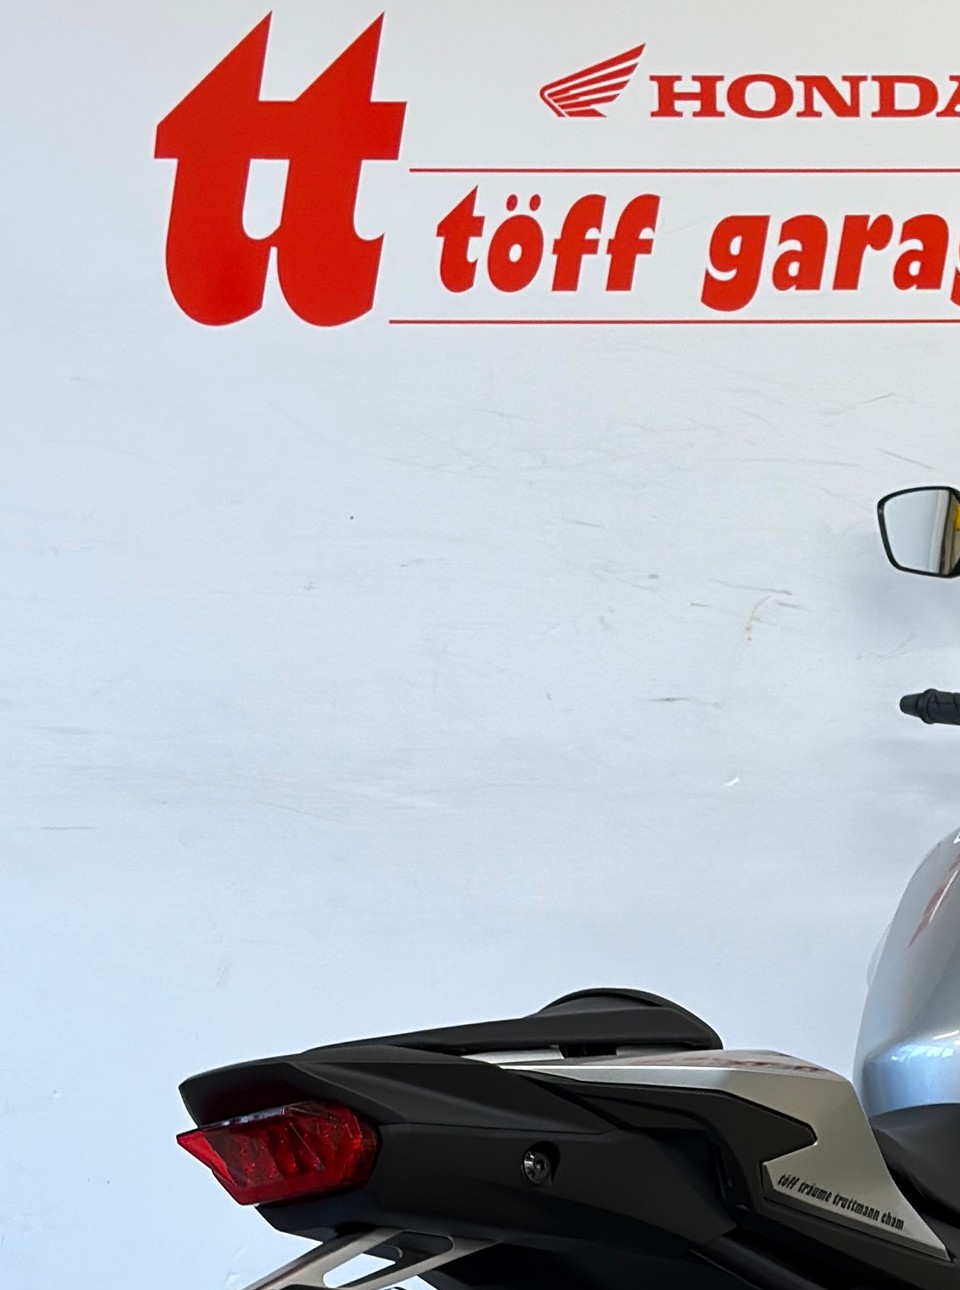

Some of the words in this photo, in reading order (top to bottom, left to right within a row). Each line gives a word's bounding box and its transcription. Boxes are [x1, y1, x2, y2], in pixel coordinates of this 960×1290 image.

[436, 185, 661, 294] töff
[832, 1193, 880, 1221] truttmann
[881, 1211, 905, 1230] cham
